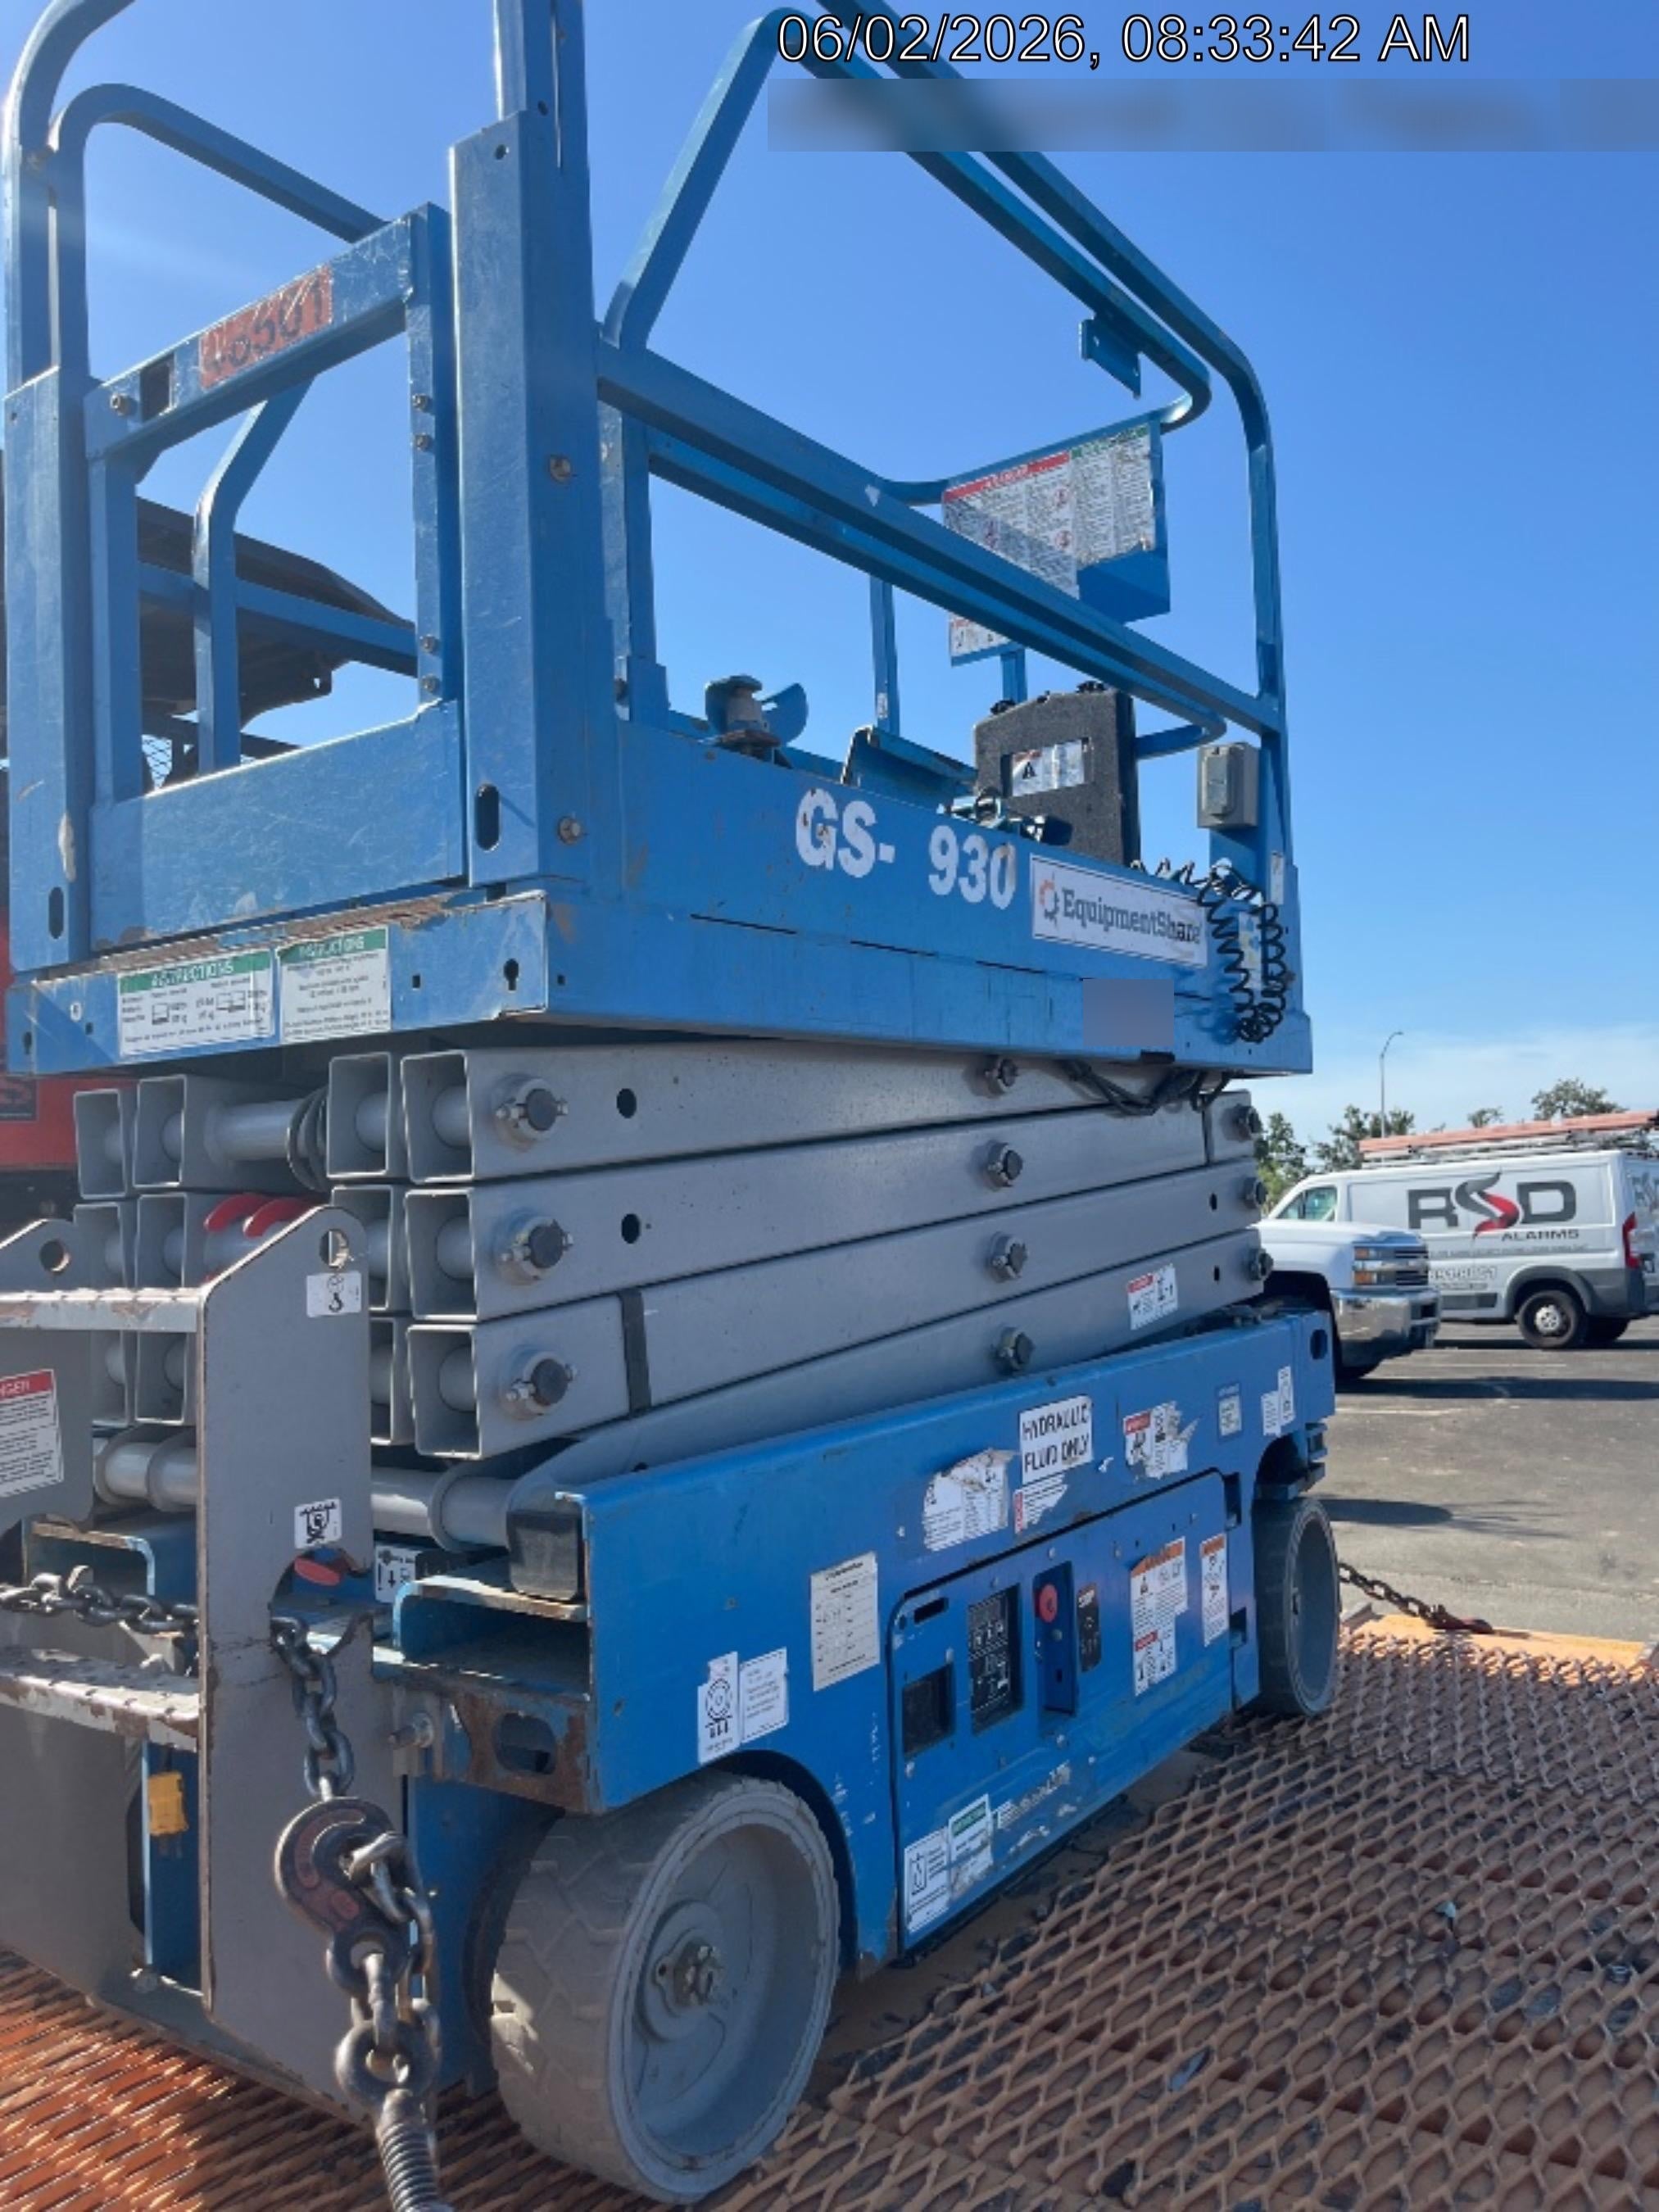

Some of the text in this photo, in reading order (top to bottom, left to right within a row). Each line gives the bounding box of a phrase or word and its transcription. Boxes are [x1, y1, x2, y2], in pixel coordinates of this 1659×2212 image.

[1407, 1168, 1576, 1237] RSD
[1501, 1229, 1580, 1241] ALARMS
[1022, 1403, 1090, 1441] HYDRAULIC
[1024, 1433, 1090, 1474] FLUID ONLY
